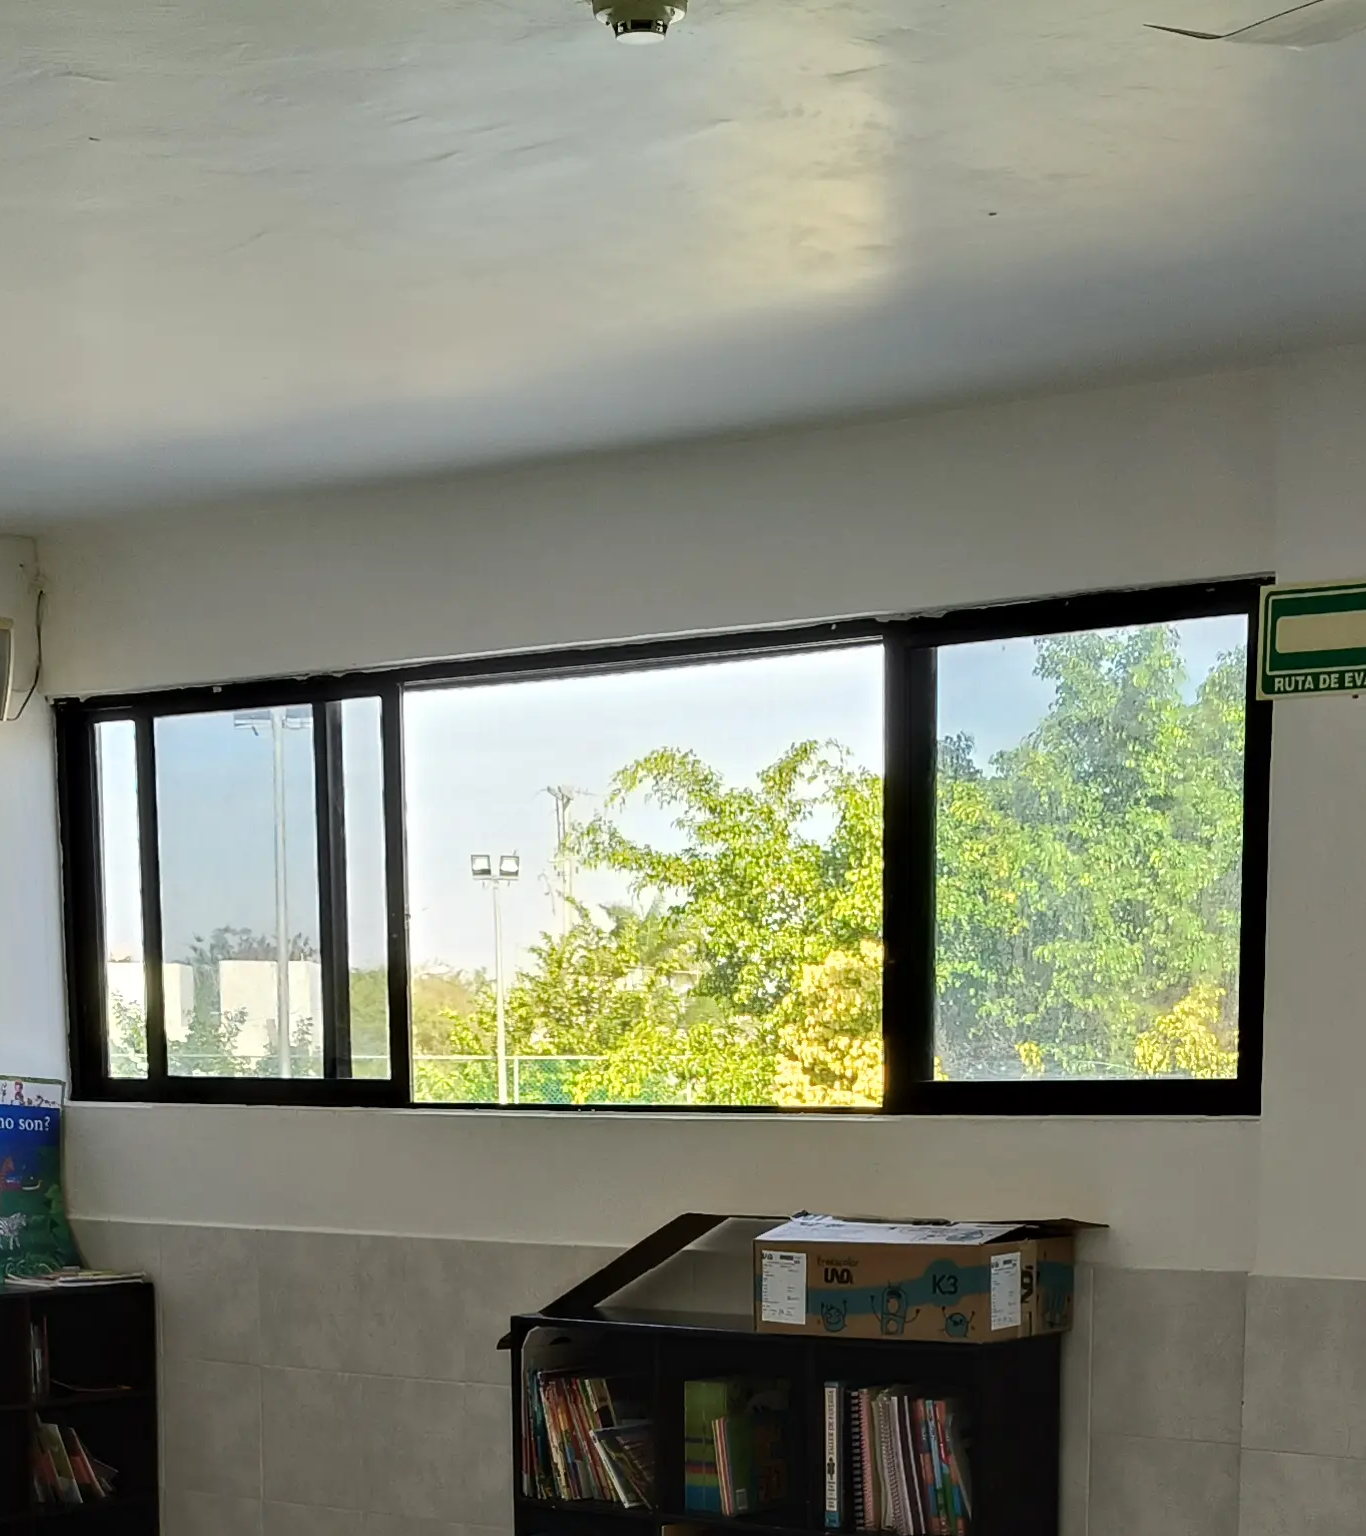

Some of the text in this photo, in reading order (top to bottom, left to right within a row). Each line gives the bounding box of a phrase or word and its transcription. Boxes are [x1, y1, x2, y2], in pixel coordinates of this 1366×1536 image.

[1274, 675, 1314, 692] RUTA
[1319, 673, 1339, 689] DE
[18, 1115, 51, 1132] son?
[932, 1274, 959, 1295] K3
